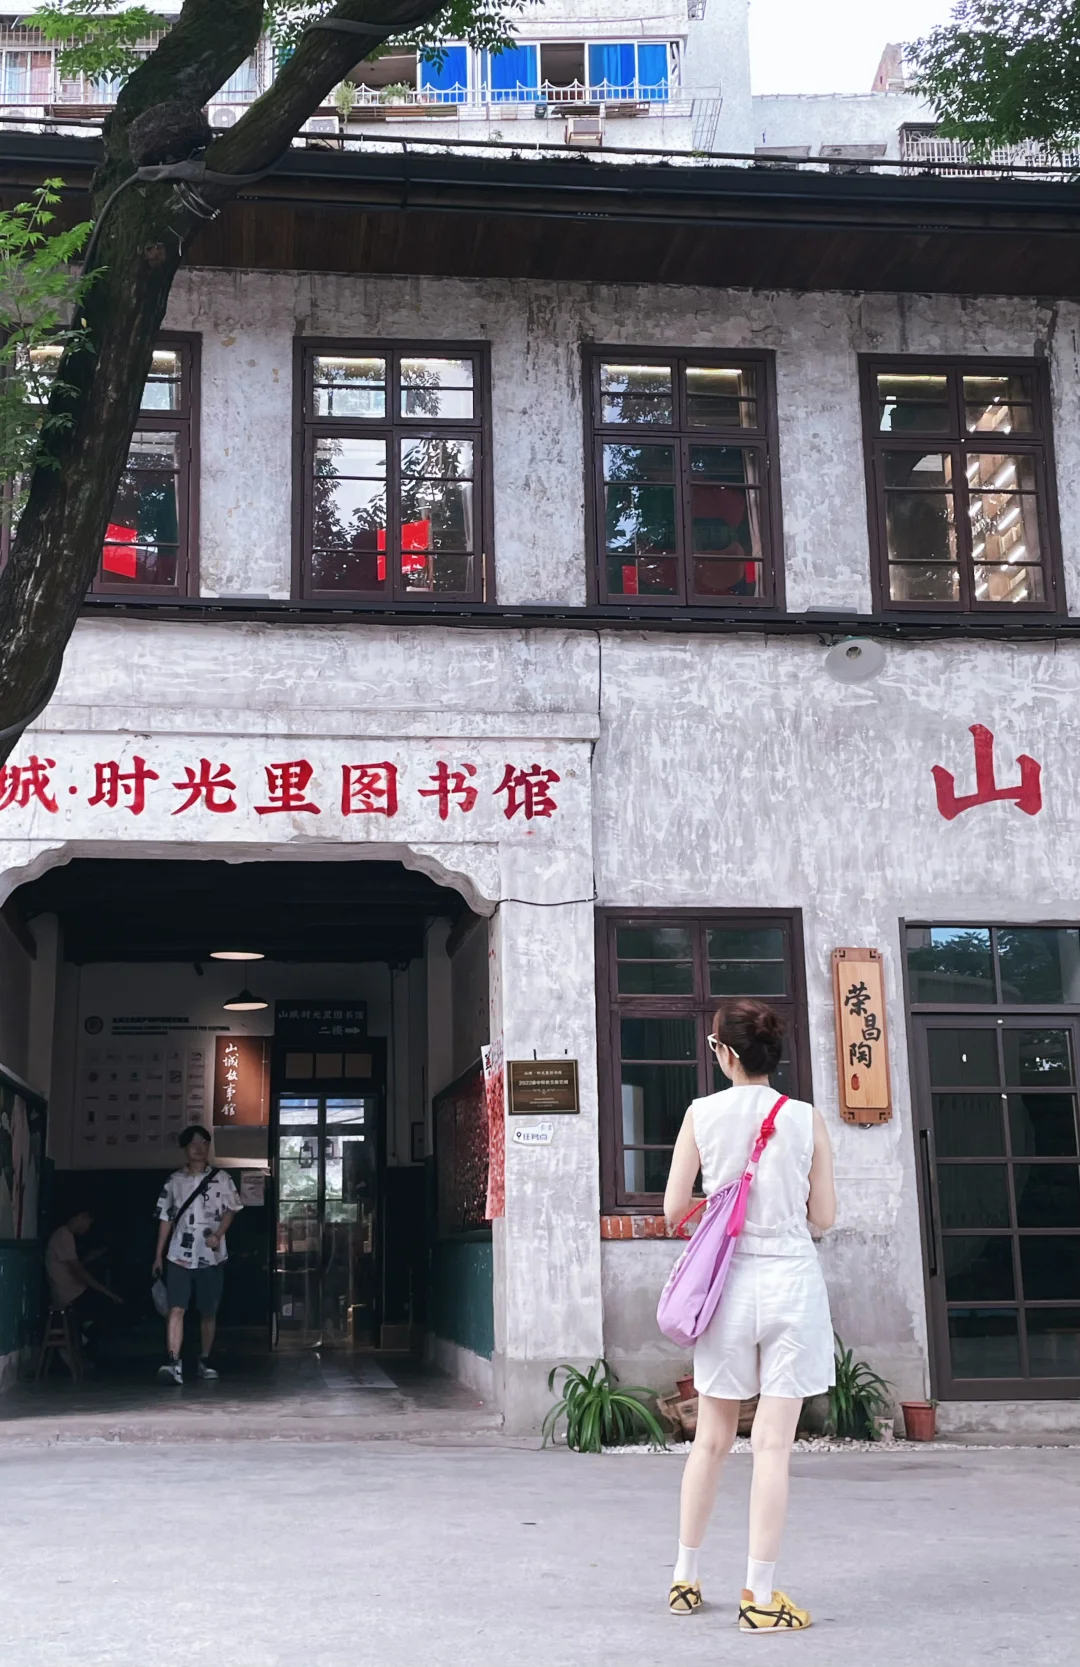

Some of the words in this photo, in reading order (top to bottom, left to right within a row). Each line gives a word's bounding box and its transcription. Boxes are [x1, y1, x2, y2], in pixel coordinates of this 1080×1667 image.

[931, 723, 1042, 821] 山
[844, 981, 882, 1069] 荣昌陶
[221, 1043, 239, 1116] 山城故事馆
